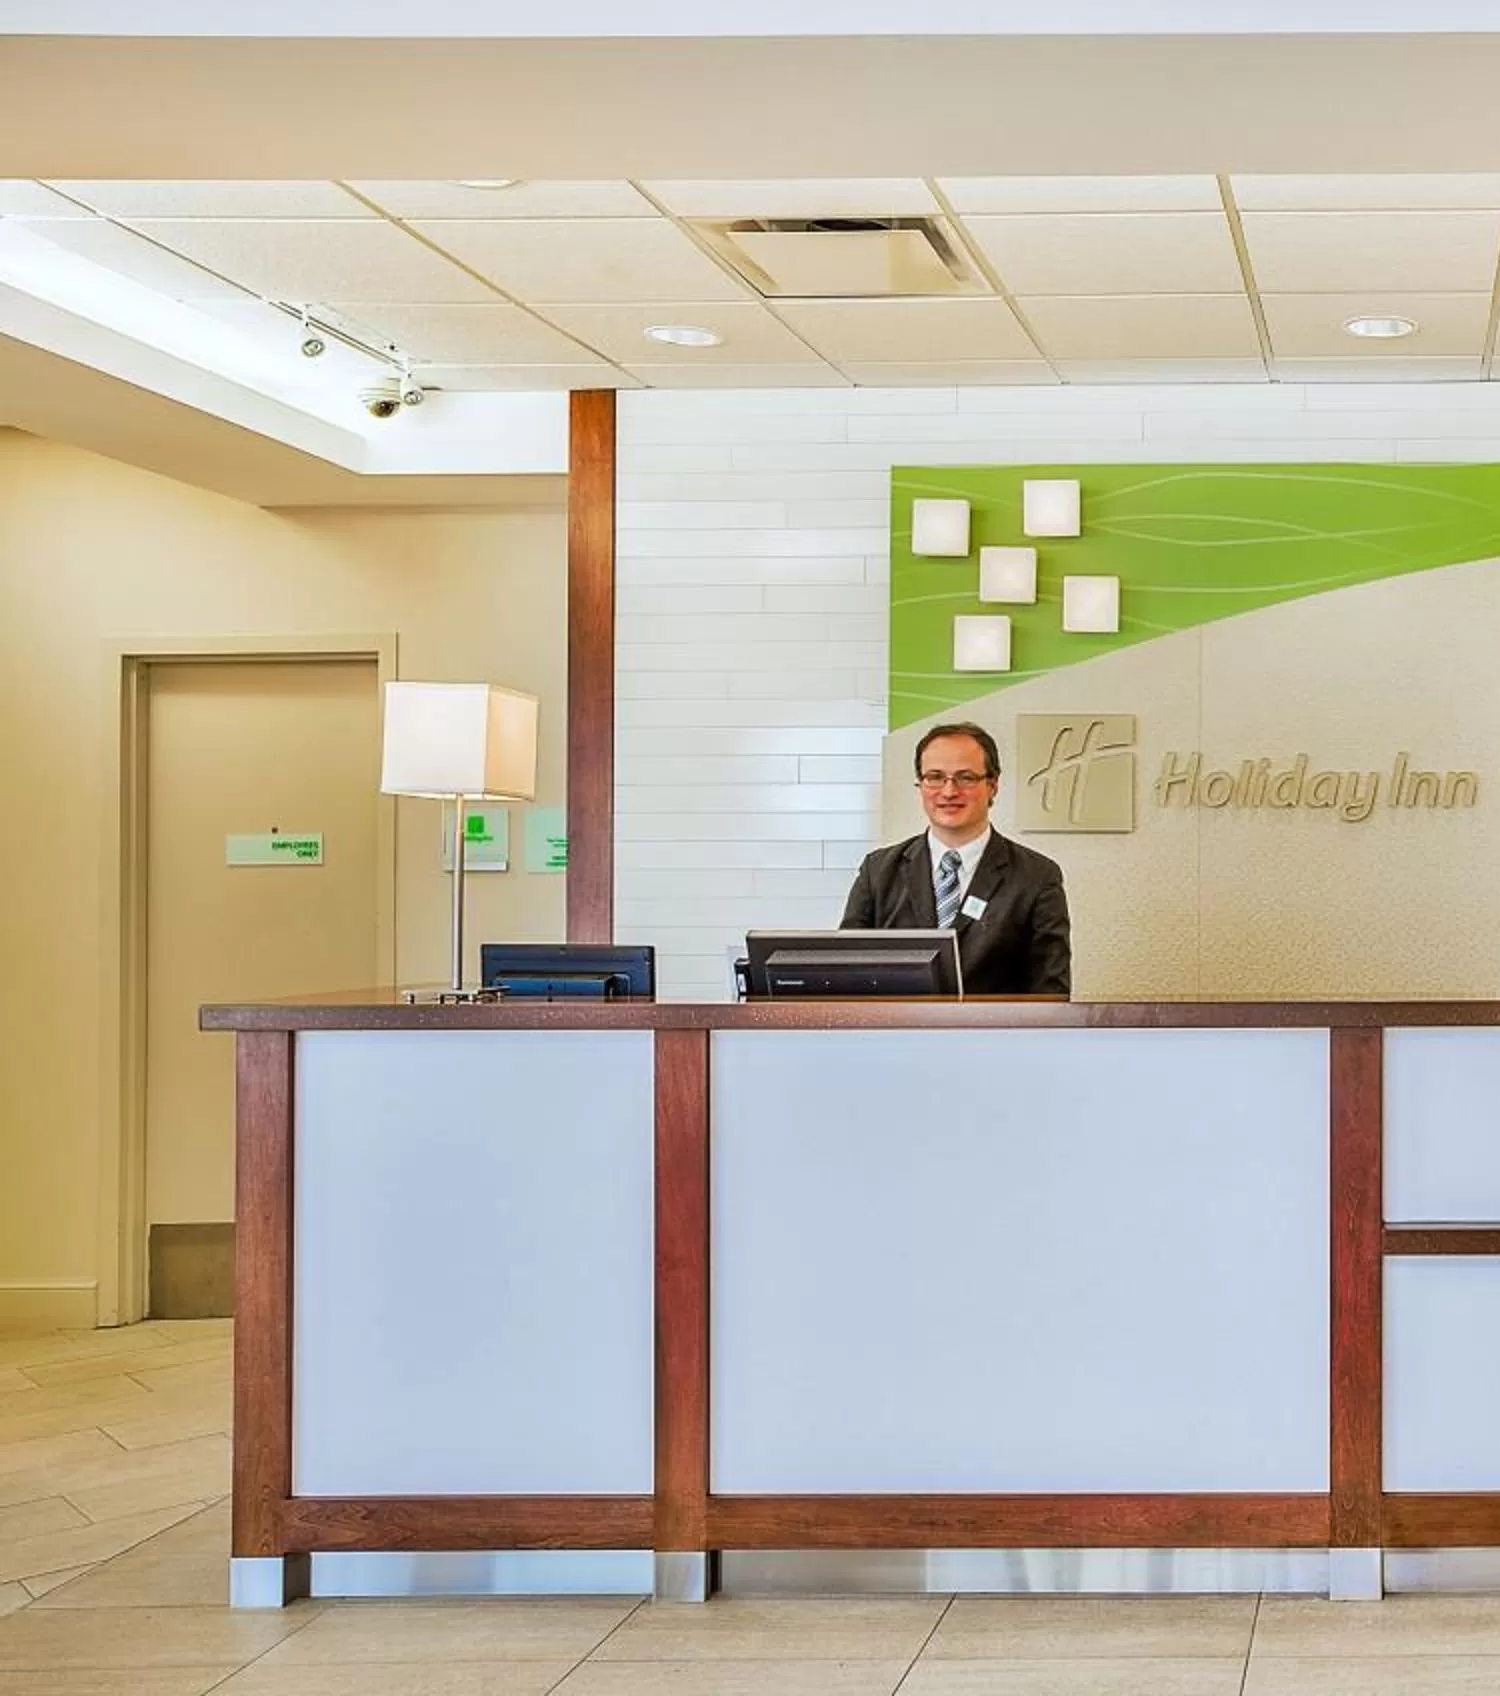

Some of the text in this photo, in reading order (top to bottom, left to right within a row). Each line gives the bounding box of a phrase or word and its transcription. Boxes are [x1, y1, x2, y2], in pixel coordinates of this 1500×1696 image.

[1155, 751, 1478, 822] Holiday Inn
[271, 841, 319, 849] EMPLOYEES
[296, 849, 319, 858] ONLY
